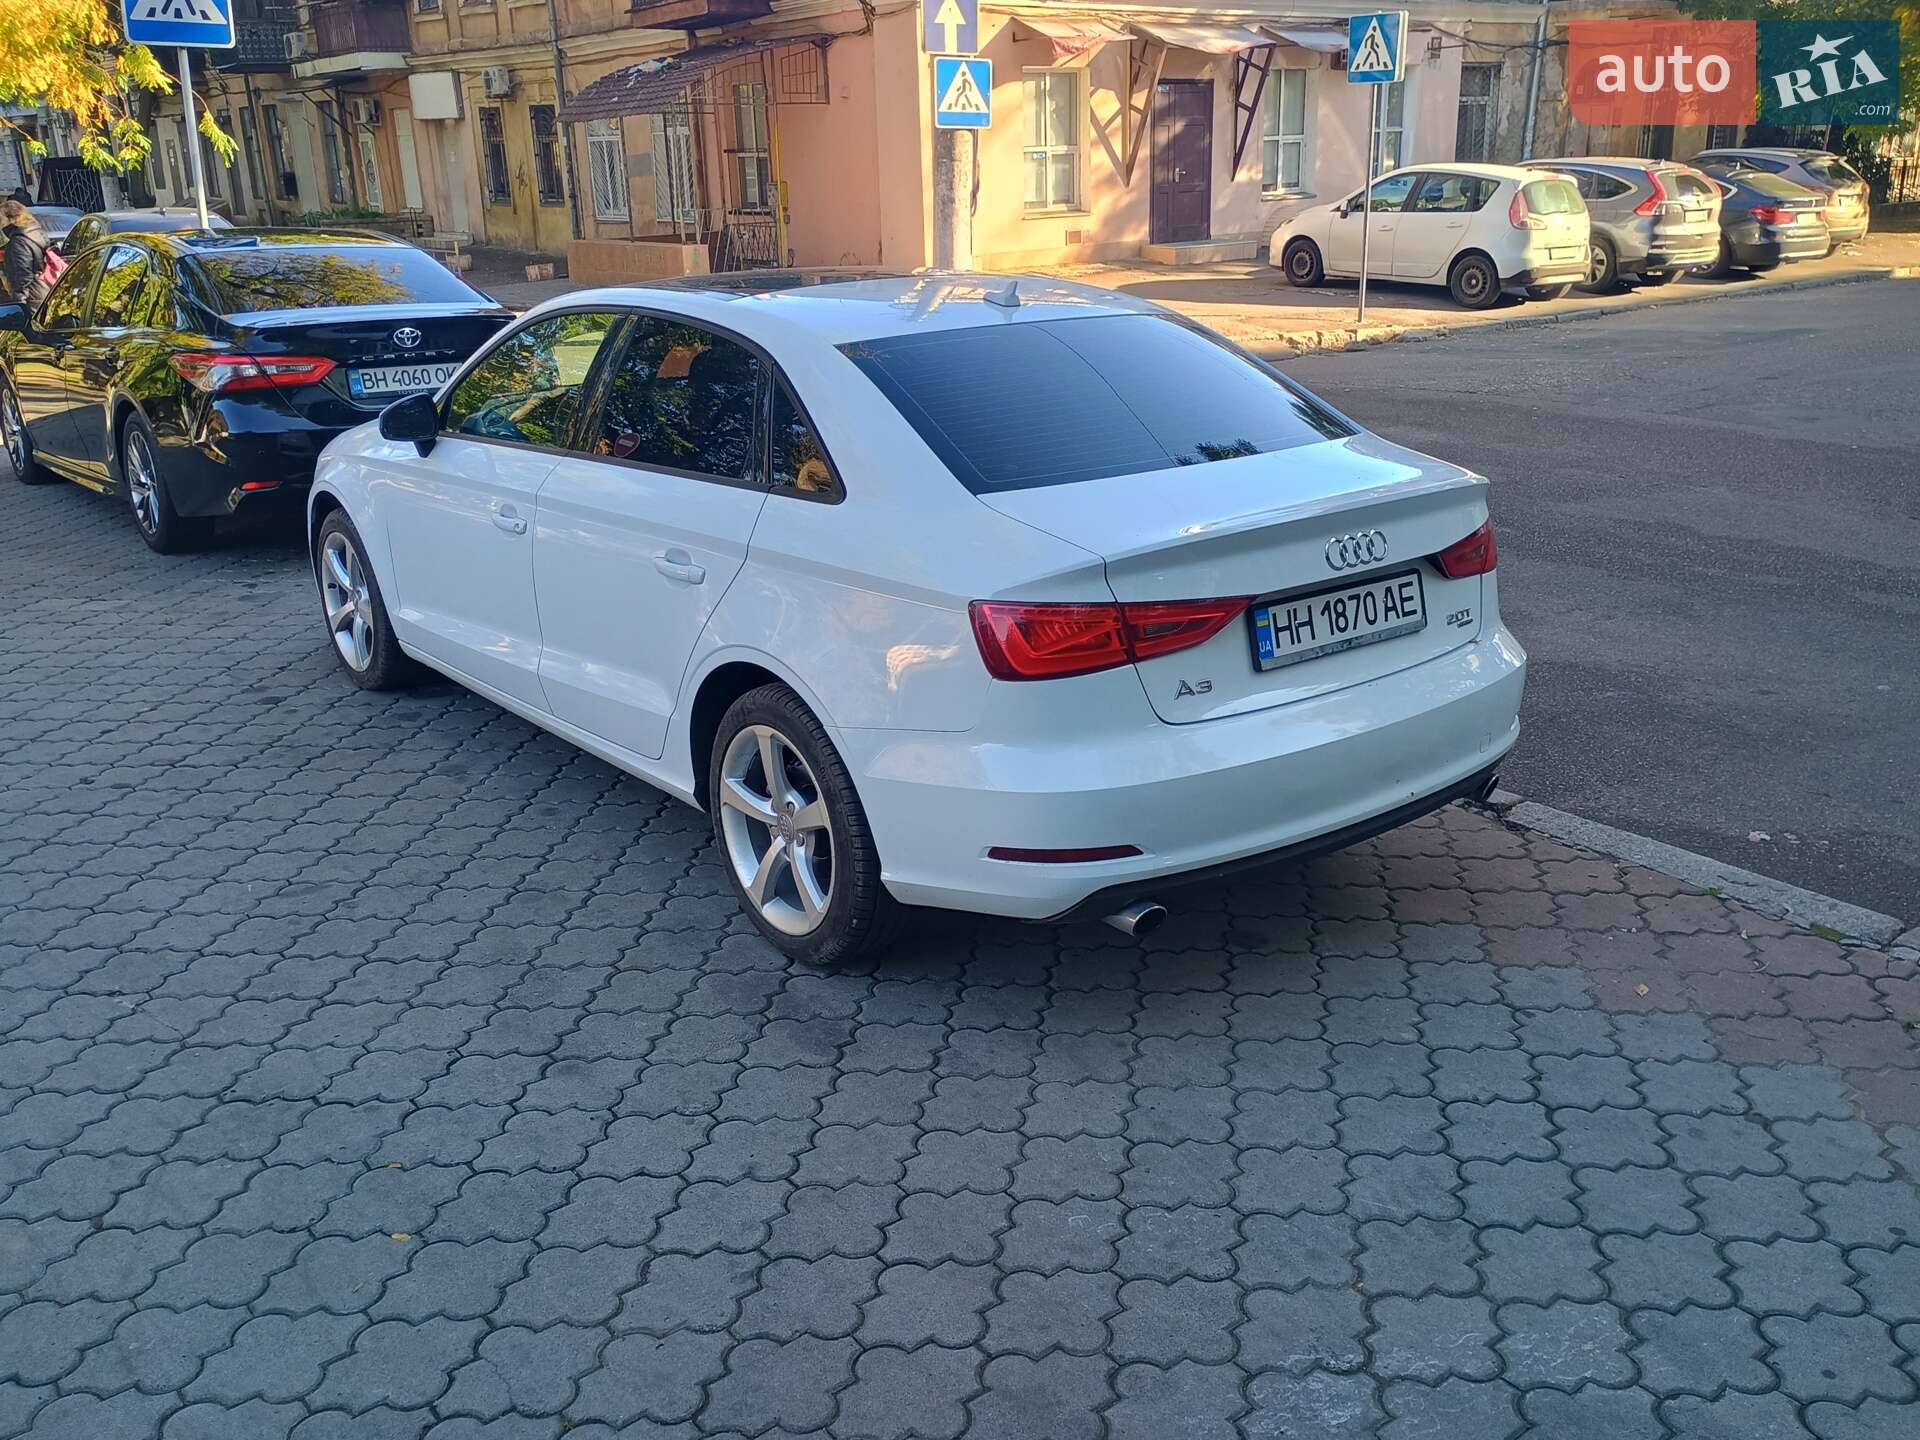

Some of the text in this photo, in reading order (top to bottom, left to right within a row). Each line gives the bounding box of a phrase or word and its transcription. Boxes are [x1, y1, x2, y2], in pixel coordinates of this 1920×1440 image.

[361, 371, 389, 390] BH
[392, 368, 431, 387] 4060
[1271, 603, 1316, 649] HH
[1320, 590, 1378, 636] 1870
[1384, 580, 1419, 622] AE
[1259, 639, 1273, 653] UA
[1174, 679, 1213, 700] A3
